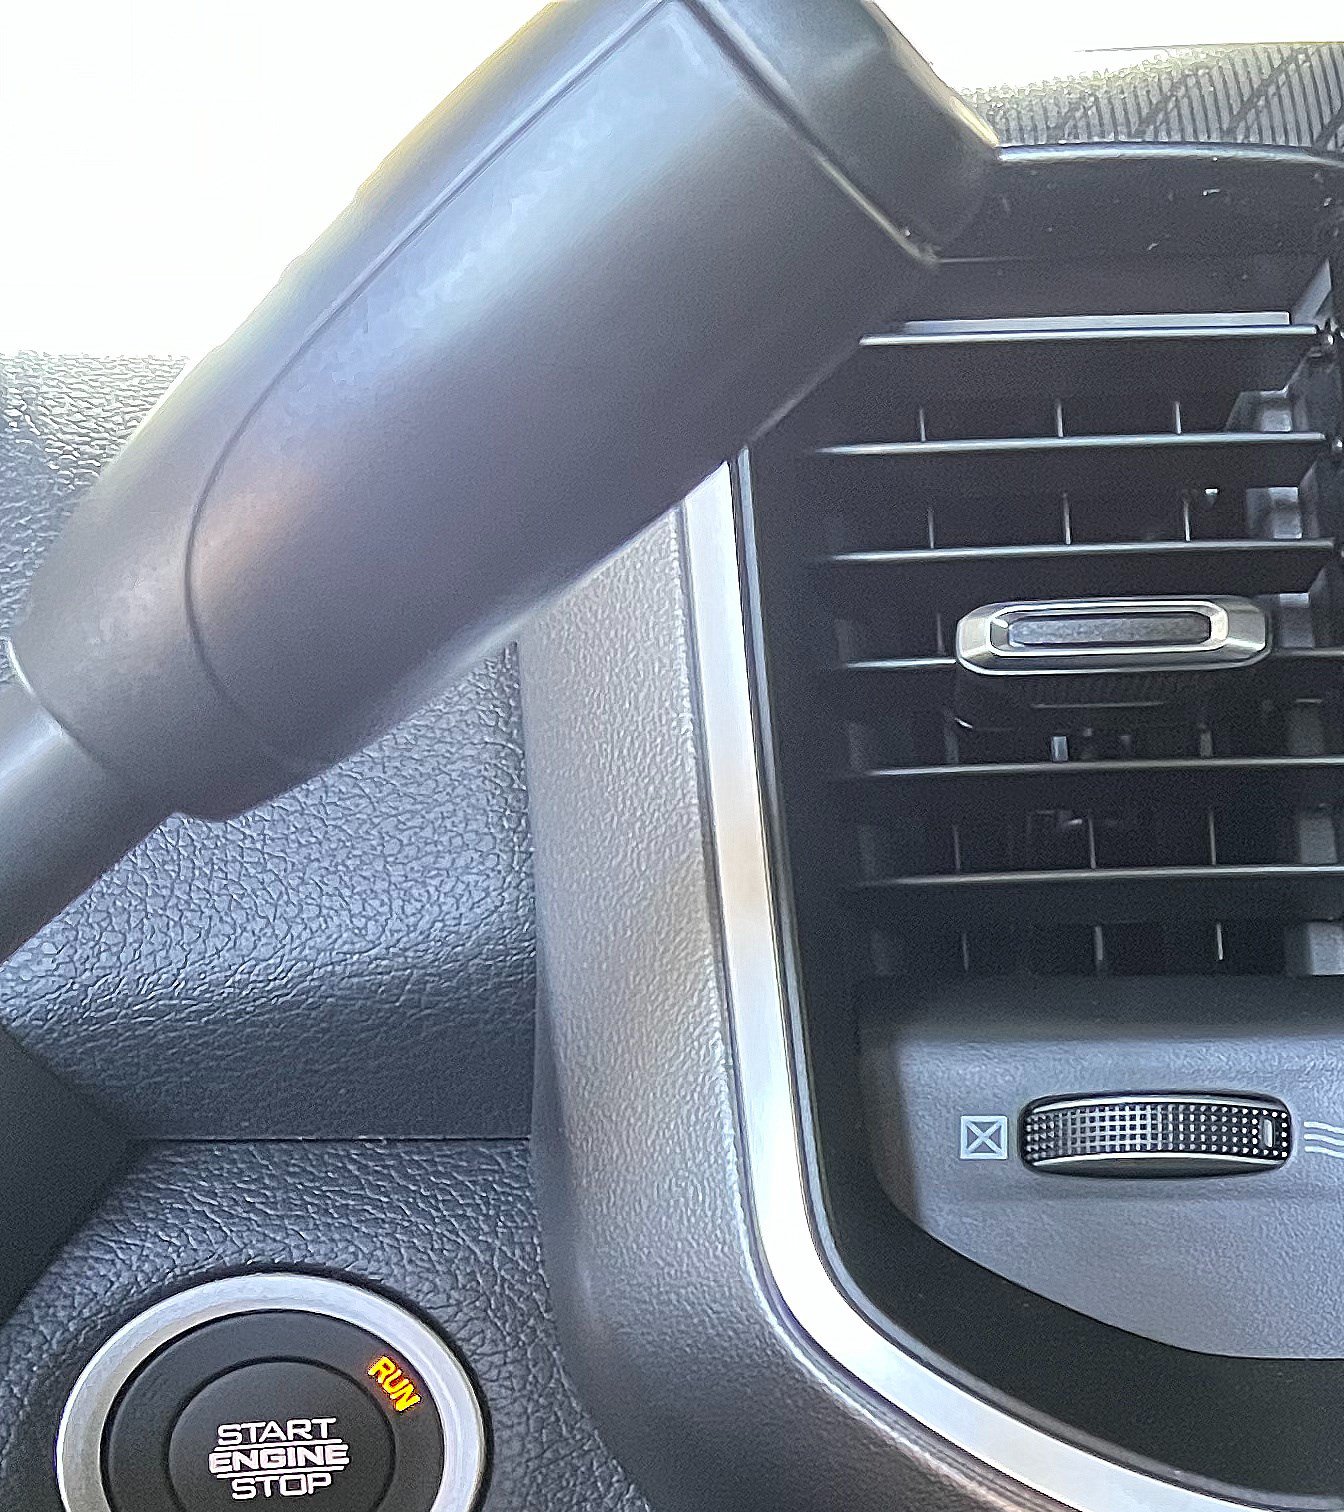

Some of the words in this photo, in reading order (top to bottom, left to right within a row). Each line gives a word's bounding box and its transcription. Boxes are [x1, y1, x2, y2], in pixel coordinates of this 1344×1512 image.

[367, 1355, 421, 1412] RUN
[217, 1417, 337, 1445] START
[207, 1442, 350, 1475] ENGINE
[230, 1472, 333, 1501] STOP
